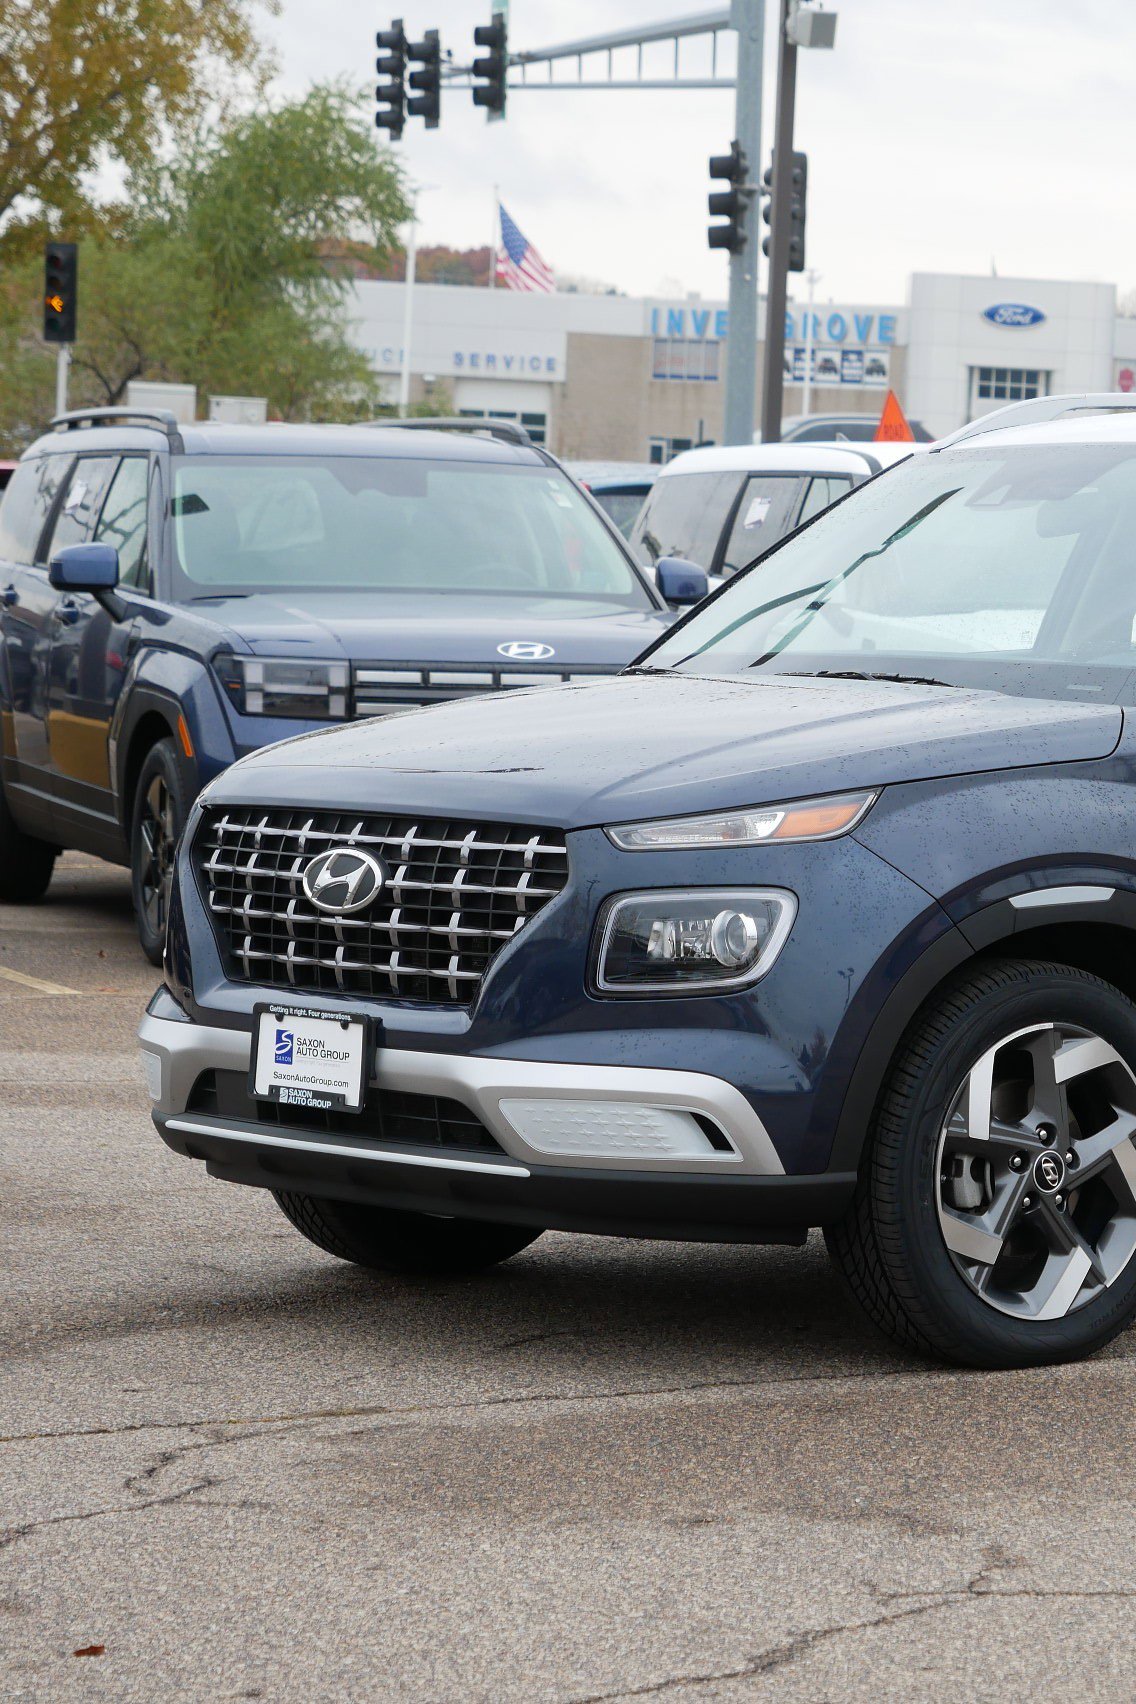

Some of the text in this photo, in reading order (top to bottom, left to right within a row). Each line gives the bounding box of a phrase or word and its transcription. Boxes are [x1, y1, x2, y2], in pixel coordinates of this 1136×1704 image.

[994, 306, 1033, 323] Ford
[652, 308, 729, 337] INVE
[453, 352, 556, 371] SERVICE
[269, 1005, 288, 1015] Getting
[308, 1009, 320, 1017] Four
[296, 1037, 325, 1049] SAXON
[296, 1047, 350, 1061] AUTO GROUP
[273, 1071, 349, 1088] SaxonAutoGroup.com
[288, 1088, 312, 1098] SAXON
[288, 1096, 332, 1109] AUTO GROUP
